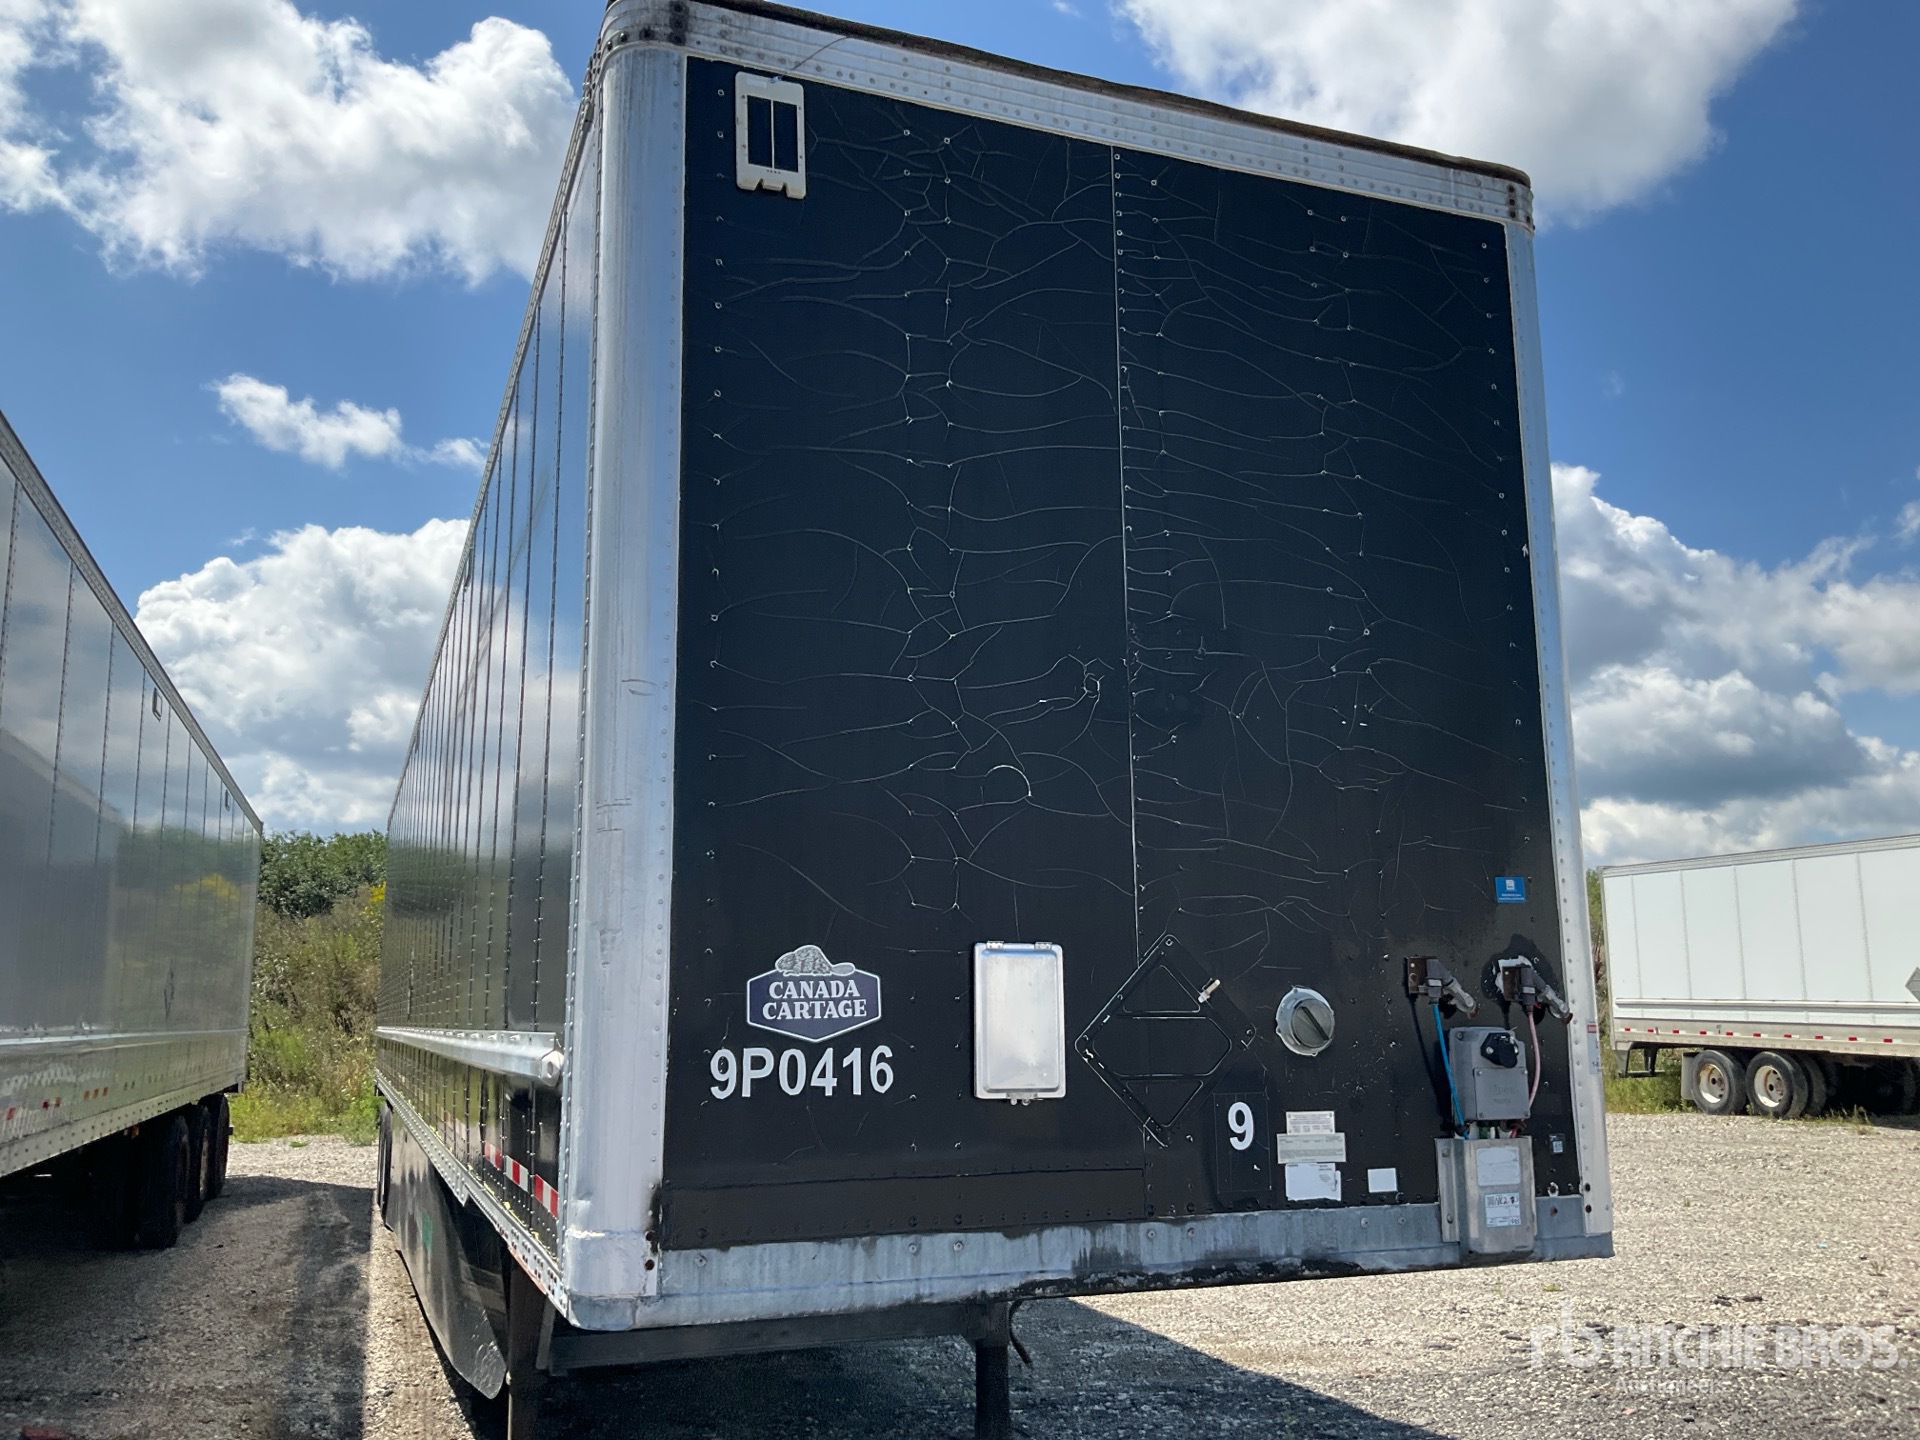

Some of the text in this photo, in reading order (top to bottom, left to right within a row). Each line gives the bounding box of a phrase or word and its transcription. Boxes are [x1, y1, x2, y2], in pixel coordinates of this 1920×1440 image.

[768, 979, 860, 999] CANADA
[762, 999, 867, 1020] CARTAGE
[709, 1045, 894, 1099] 9P0416
[1227, 1101, 1255, 1151] 9
